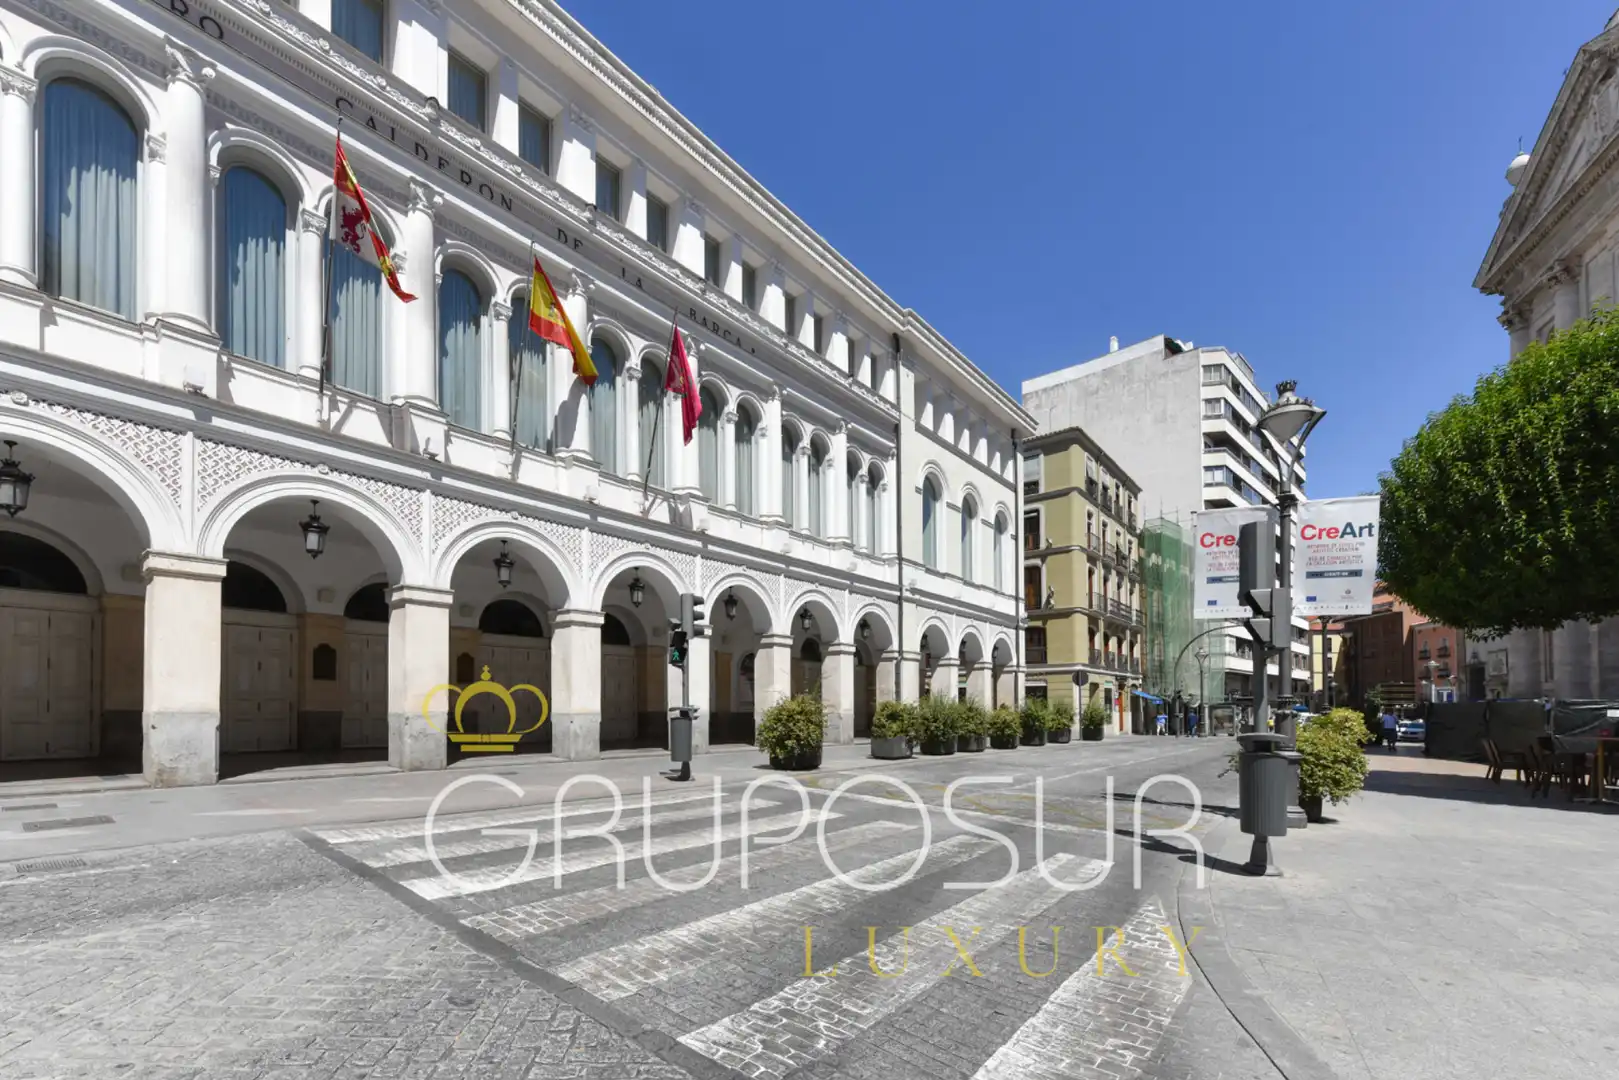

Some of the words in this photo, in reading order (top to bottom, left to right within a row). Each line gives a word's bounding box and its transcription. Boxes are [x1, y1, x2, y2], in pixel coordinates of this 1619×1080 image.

[557, 228, 584, 250] DE
[1199, 532, 1240, 548] Cre
[1300, 521, 1375, 541] CreArt
